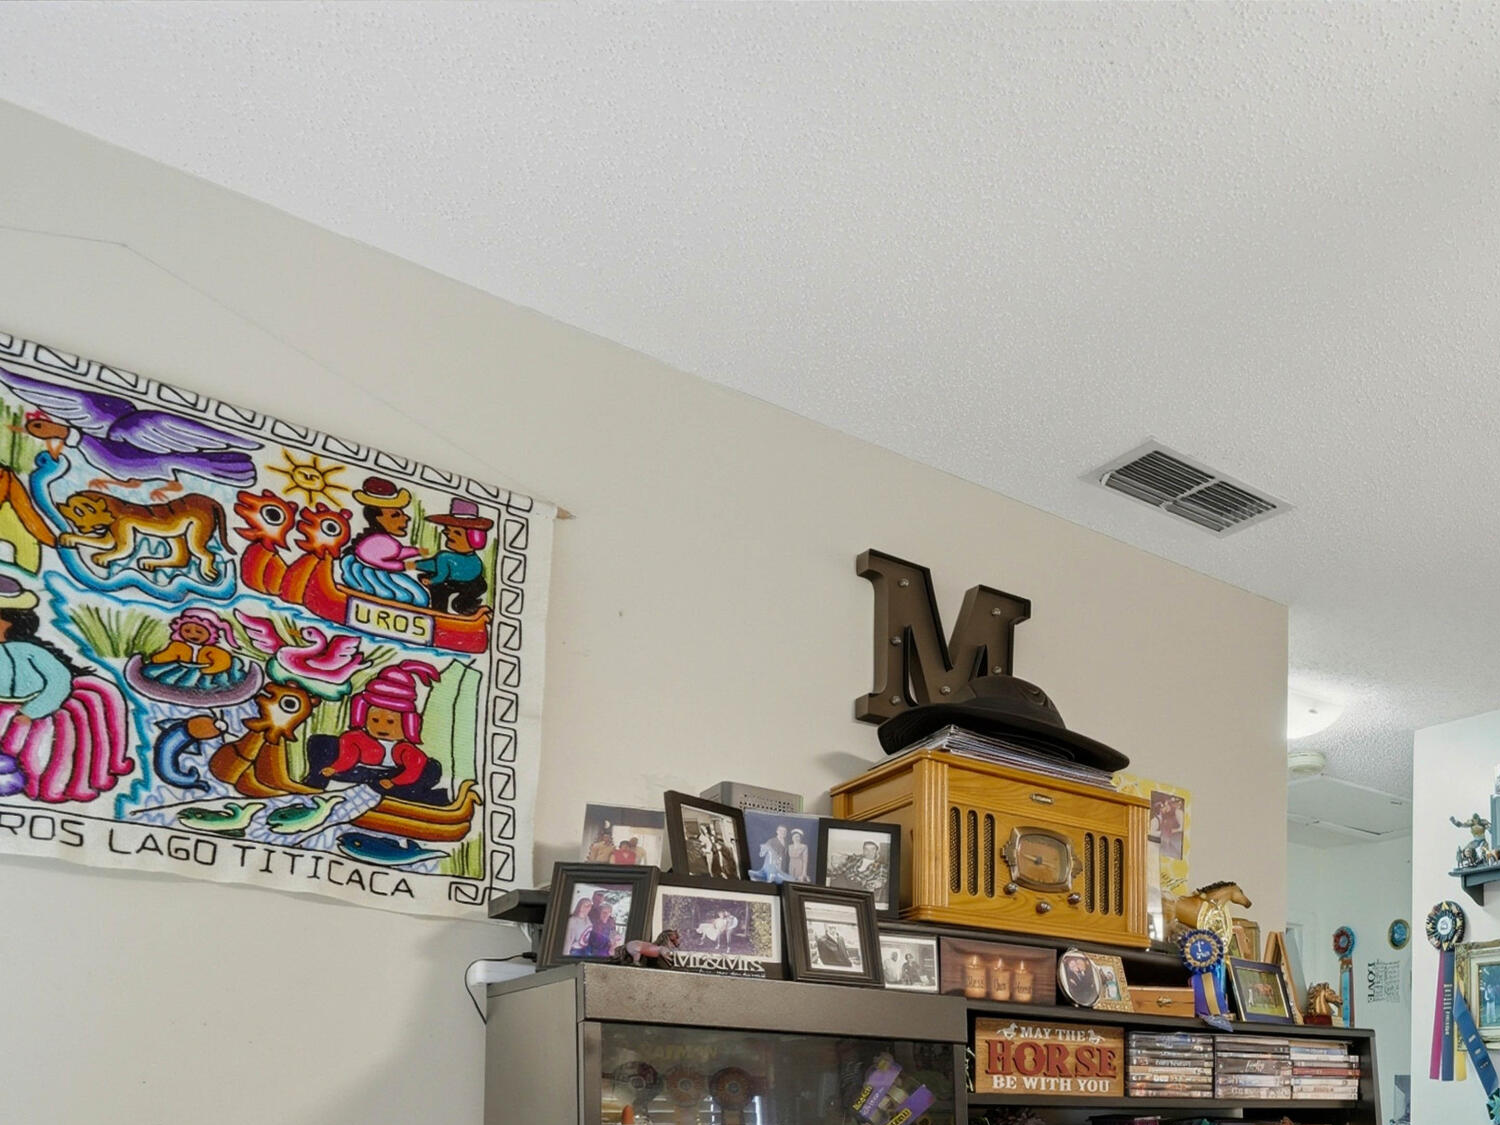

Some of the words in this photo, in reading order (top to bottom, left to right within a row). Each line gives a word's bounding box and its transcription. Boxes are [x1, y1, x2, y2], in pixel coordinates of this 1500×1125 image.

[355, 604, 425, 636] UROS
[109, 829, 218, 867] LAGO
[234, 844, 415, 898] TITICACA
[1020, 1026, 1051, 1040] MAY
[1055, 1029, 1086, 1043] THE
[985, 1040, 1117, 1079] HORSE
[992, 1075, 1017, 1090] BE
[1022, 1076, 1072, 1092] WITH
[1077, 1079, 1110, 1094] YOU
